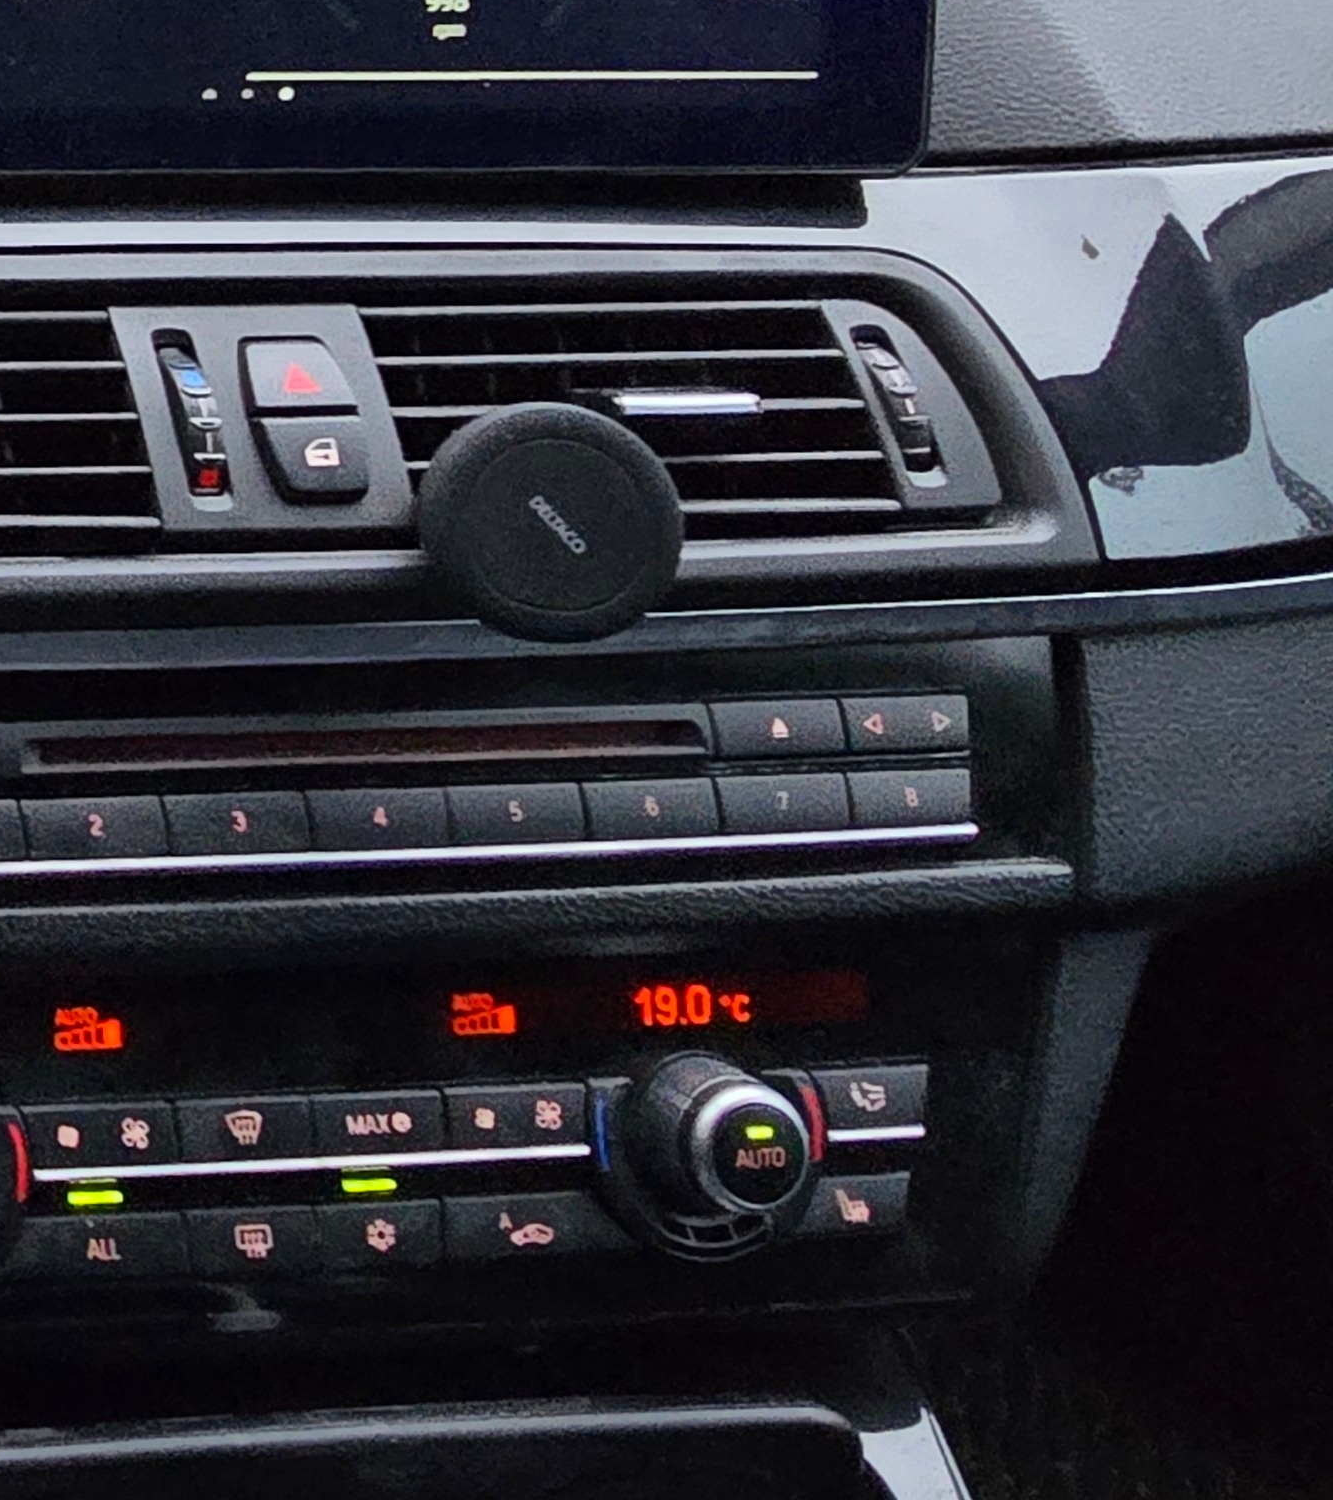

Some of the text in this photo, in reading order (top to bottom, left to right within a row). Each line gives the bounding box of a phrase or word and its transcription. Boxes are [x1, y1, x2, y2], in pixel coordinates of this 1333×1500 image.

[89, 814, 105, 837] 2
[232, 811, 247, 832] 3
[374, 806, 388, 825] 4
[509, 800, 524, 821] 5
[644, 795, 660, 816] 6
[776, 791, 789, 809] 7
[346, 1114, 390, 1134] MAX
[736, 1146, 785, 1169] AUTO
[87, 1239, 121, 1260] ALL
